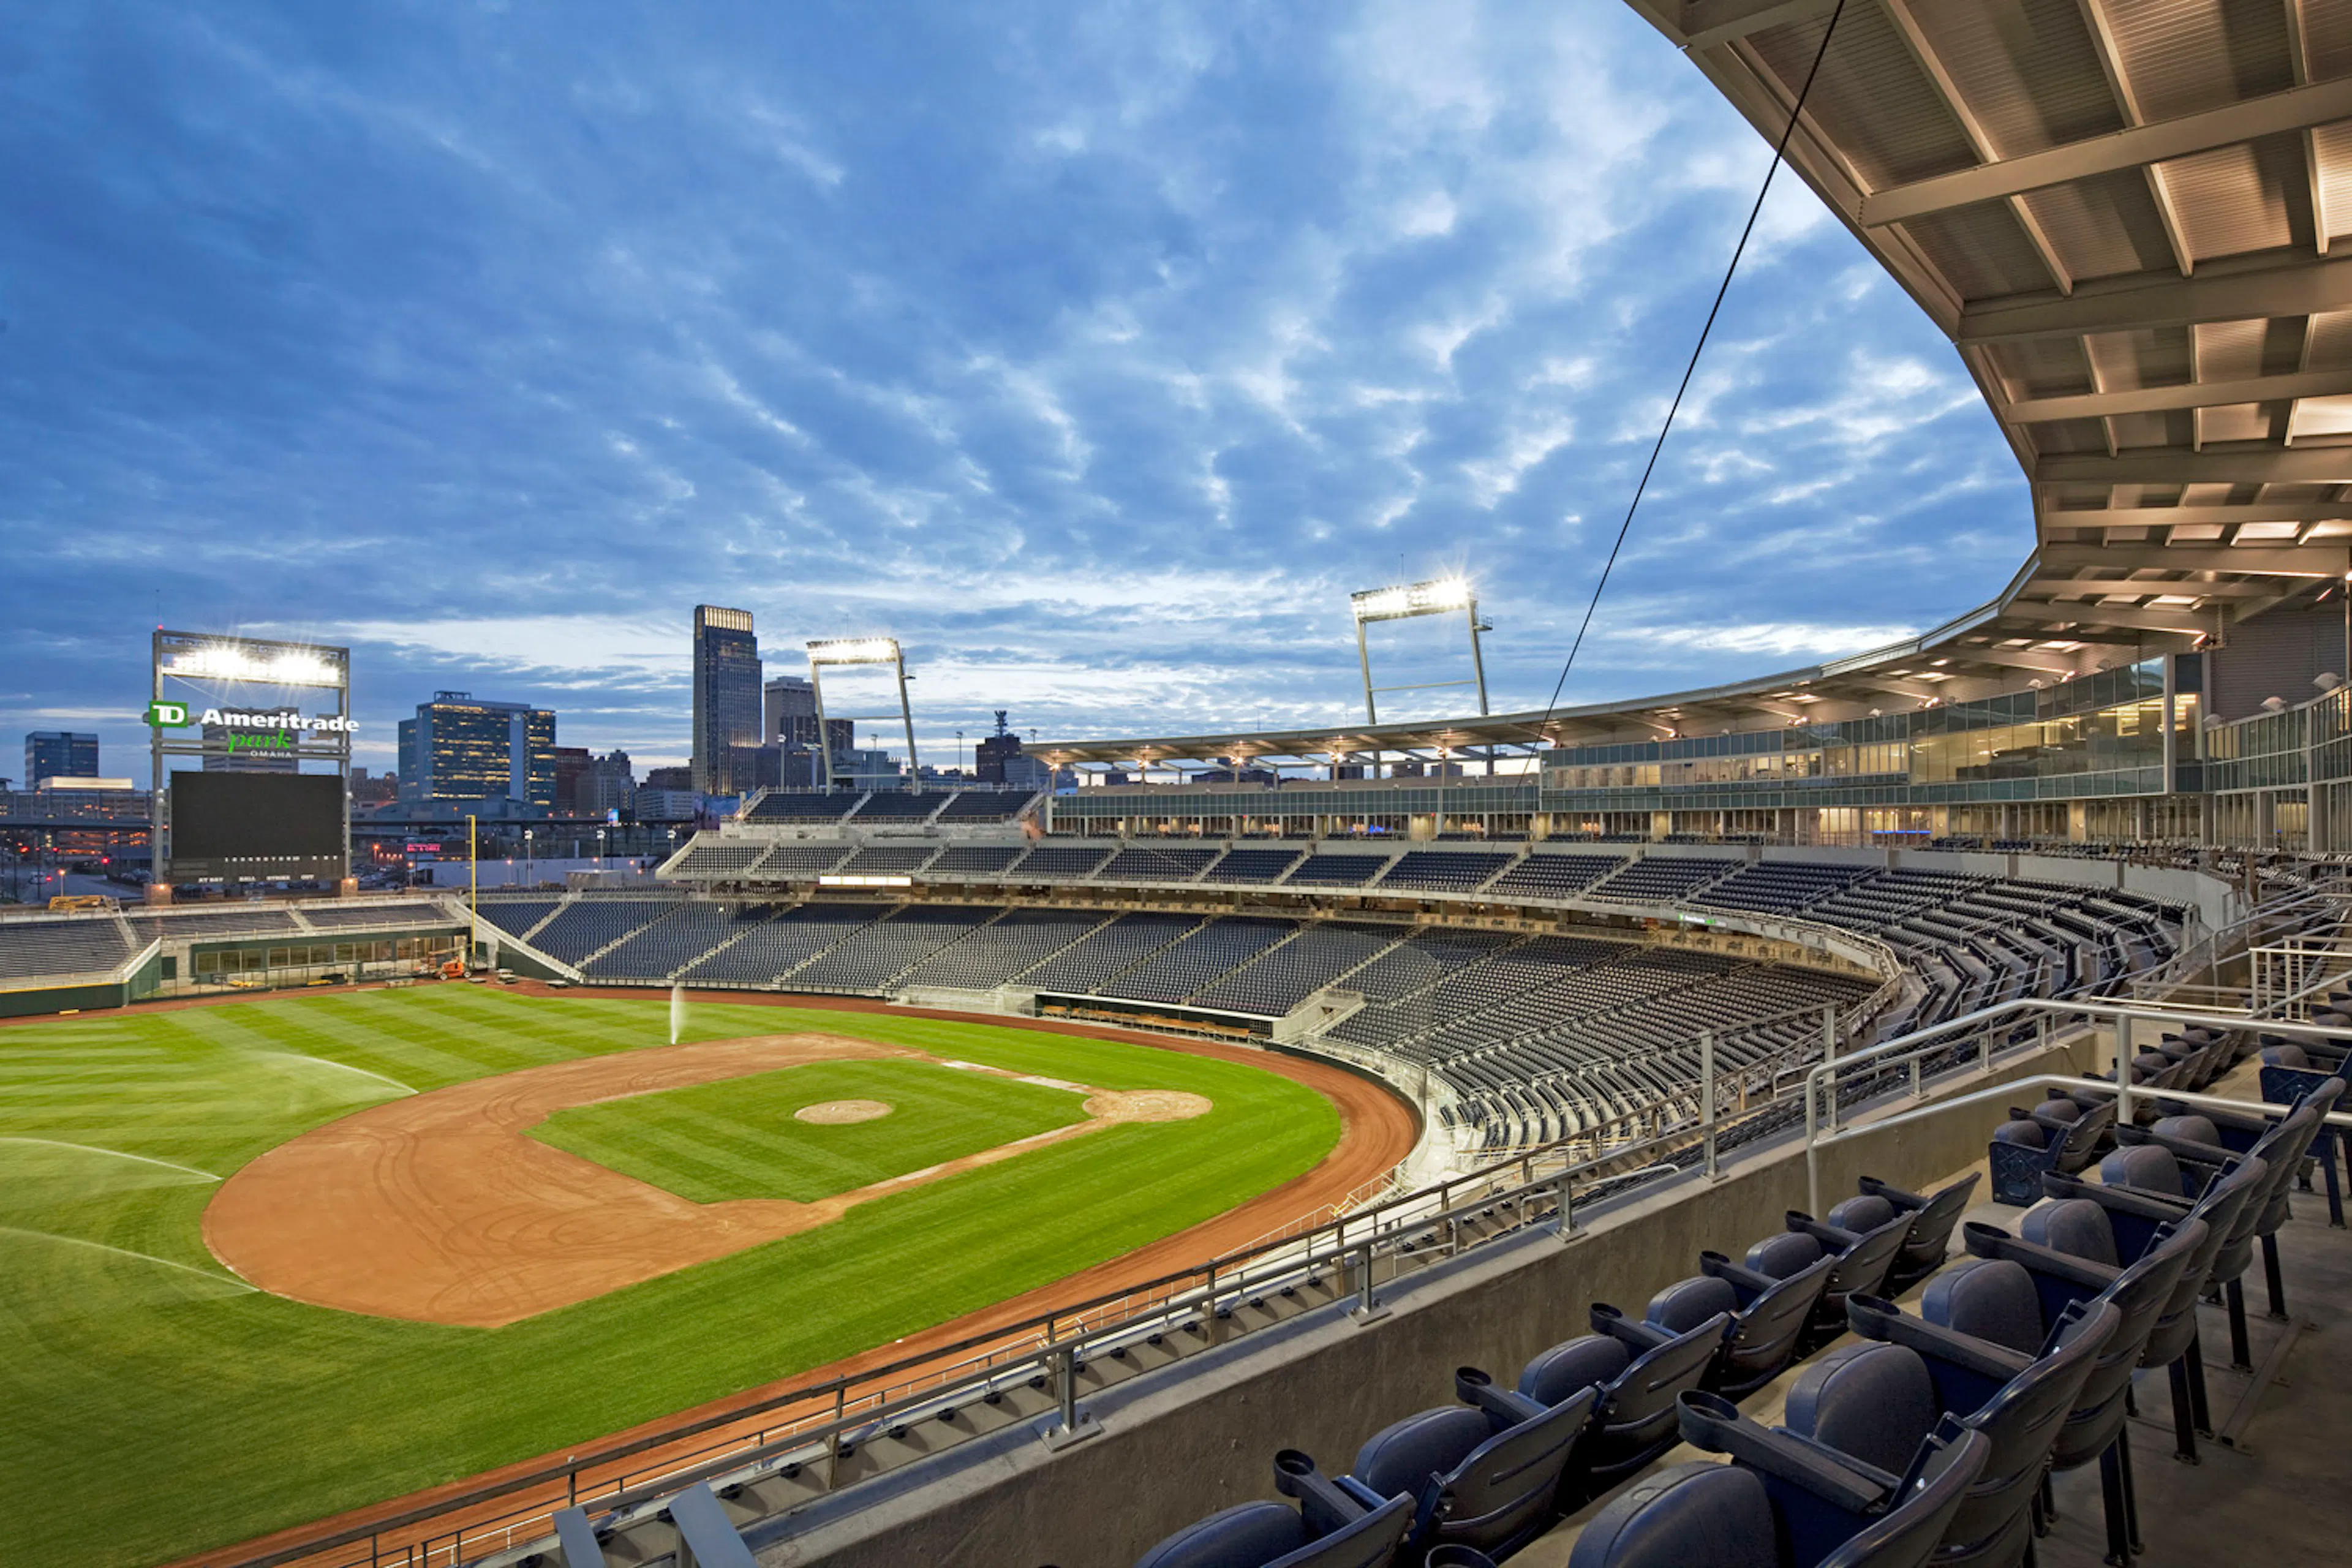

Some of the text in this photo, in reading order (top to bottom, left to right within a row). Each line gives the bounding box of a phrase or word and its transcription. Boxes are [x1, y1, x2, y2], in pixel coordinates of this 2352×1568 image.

[153, 705, 360, 732] TD Ameritrade
[228, 728, 292, 753] park
[250, 750, 293, 758] OMAHA
